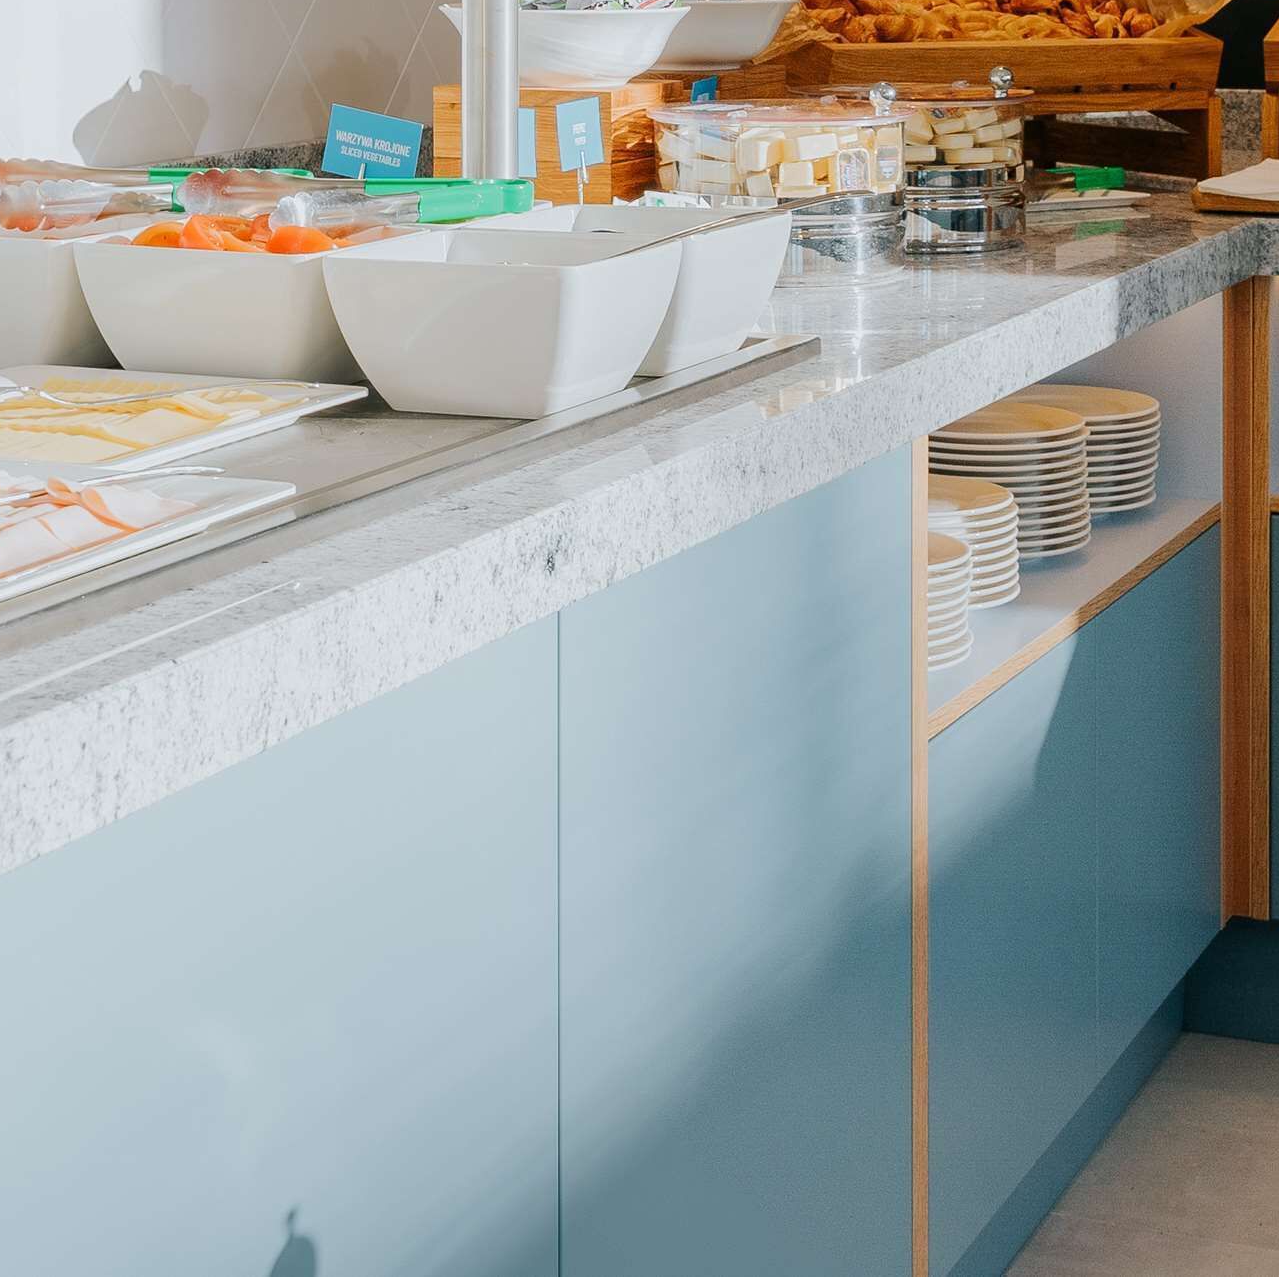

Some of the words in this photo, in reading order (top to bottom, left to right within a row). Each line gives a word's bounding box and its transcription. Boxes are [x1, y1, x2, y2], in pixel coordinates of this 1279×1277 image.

[336, 130, 373, 149] WARZYWA
[374, 138, 411, 157] KROJONE
[341, 145, 363, 159] SLICED
[362, 151, 401, 167] VEGETABLES
